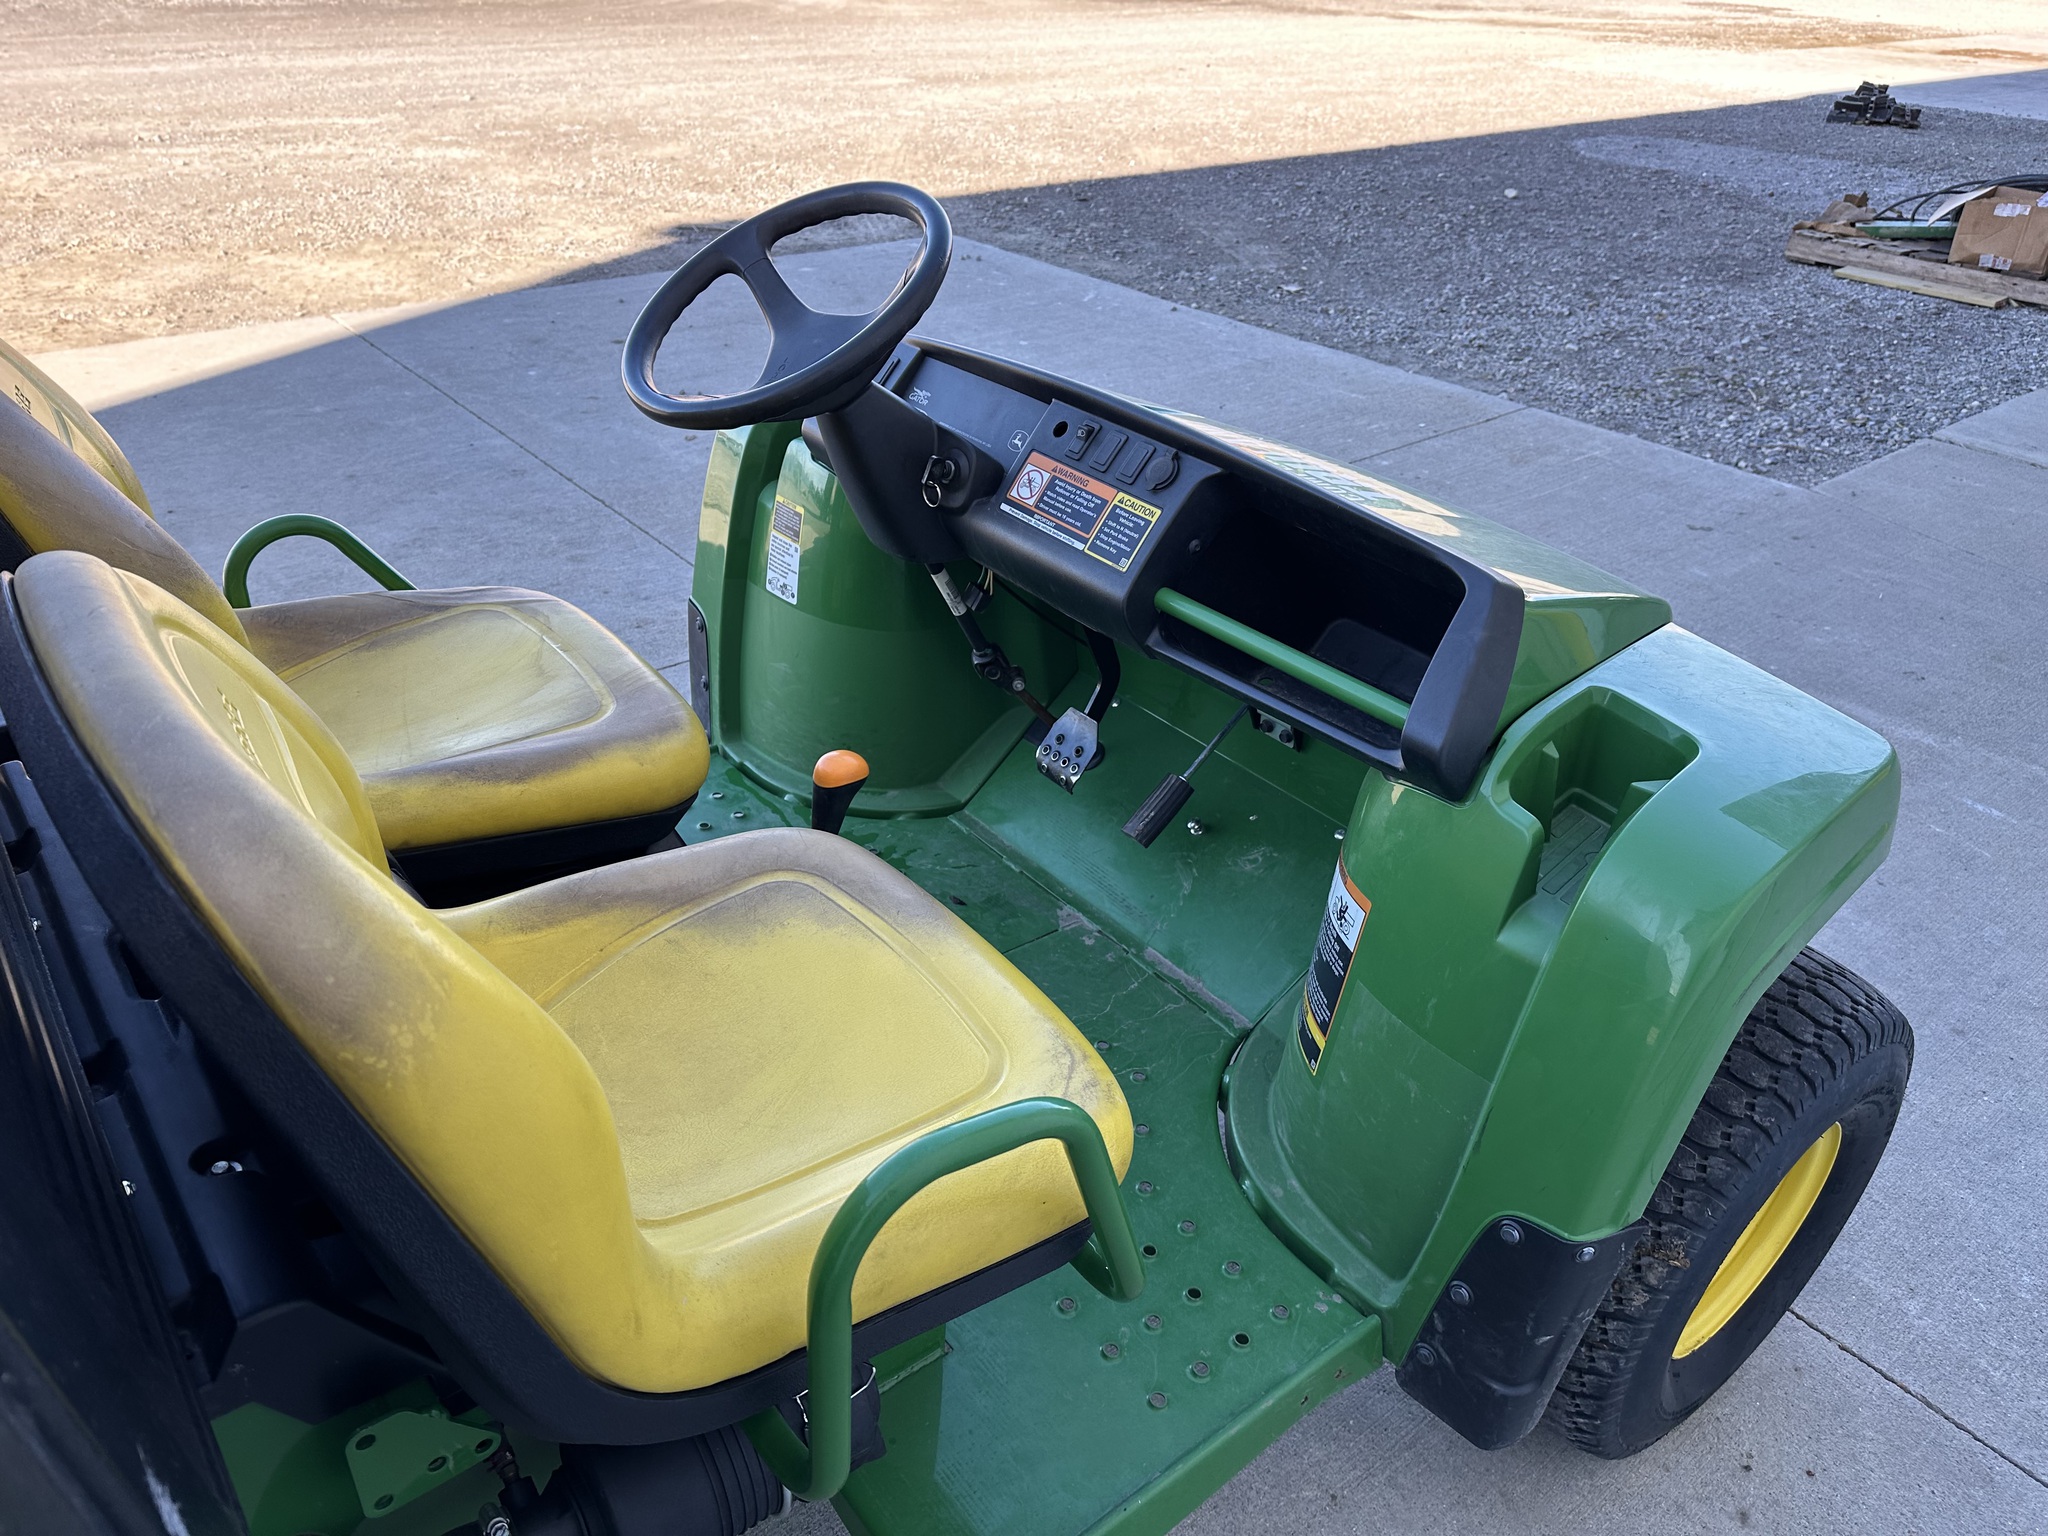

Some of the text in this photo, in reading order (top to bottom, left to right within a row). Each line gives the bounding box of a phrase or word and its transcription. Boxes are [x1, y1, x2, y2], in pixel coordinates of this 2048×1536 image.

[908, 392, 929, 406] GATOR
[1056, 467, 1090, 487] WARNING
[1054, 478, 1066, 487] Avoid
[1064, 483, 1076, 493] Injury
[1080, 491, 1092, 500] Death
[1091, 496, 1101, 504] from
[1054, 485, 1071, 497] Rollover
[1073, 495, 1088, 506] Falling
[1042, 495, 1055, 504] Manual
[1054, 501, 1065, 509] before
[1045, 490, 1057, 498] Watch
[1078, 506, 1096, 518] Operator's
[1122, 498, 1157, 518] CAUTION
[1008, 507, 1020, 516] Prevent
[1040, 524, 1052, 533] vehicle
[1051, 530, 1063, 538] before
[1033, 513, 1055, 527] IMPORTANT
[1038, 502, 1049, 511] Driver
[1064, 516, 1077, 525] years
[1114, 507, 1146, 526] Before Leaving
[1094, 539, 1117, 554] Remove Key
[1098, 533, 1109, 541] Stop
[1117, 533, 1129, 542] Brake
